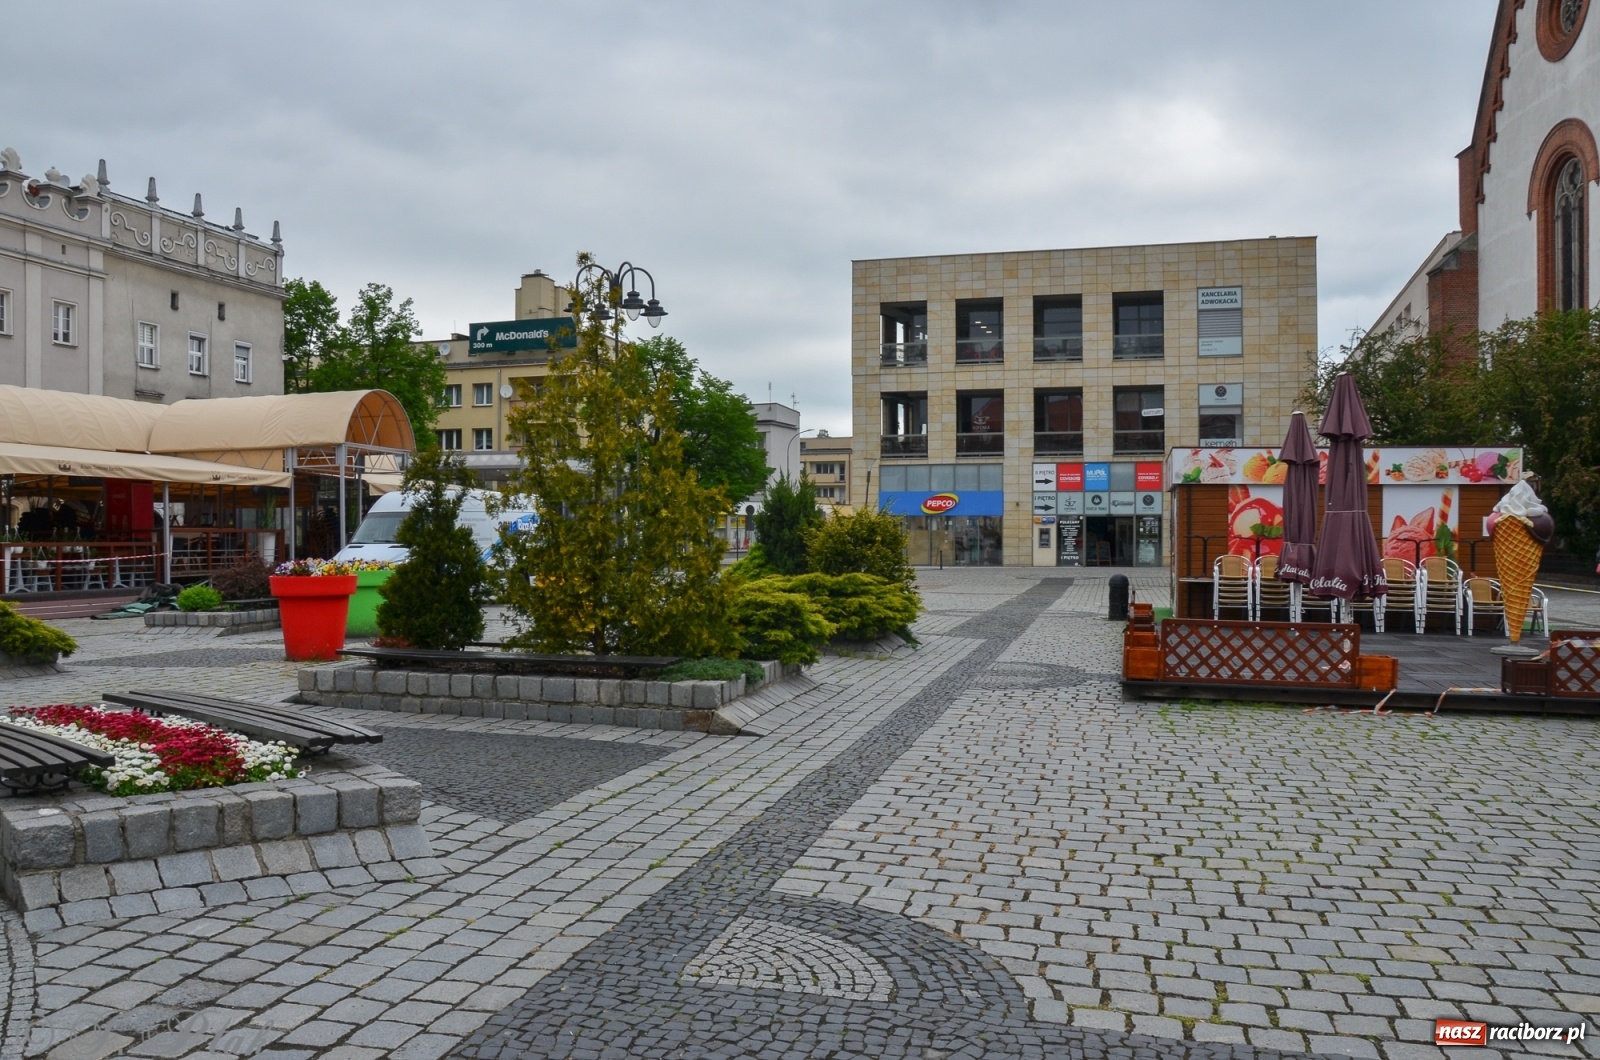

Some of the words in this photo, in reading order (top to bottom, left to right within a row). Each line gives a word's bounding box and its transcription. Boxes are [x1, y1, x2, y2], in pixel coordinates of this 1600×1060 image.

[1201, 290, 1237, 298] KANCELARIA
[495, 329, 549, 341] McDonald's
[926, 499, 953, 507] PEPCO
